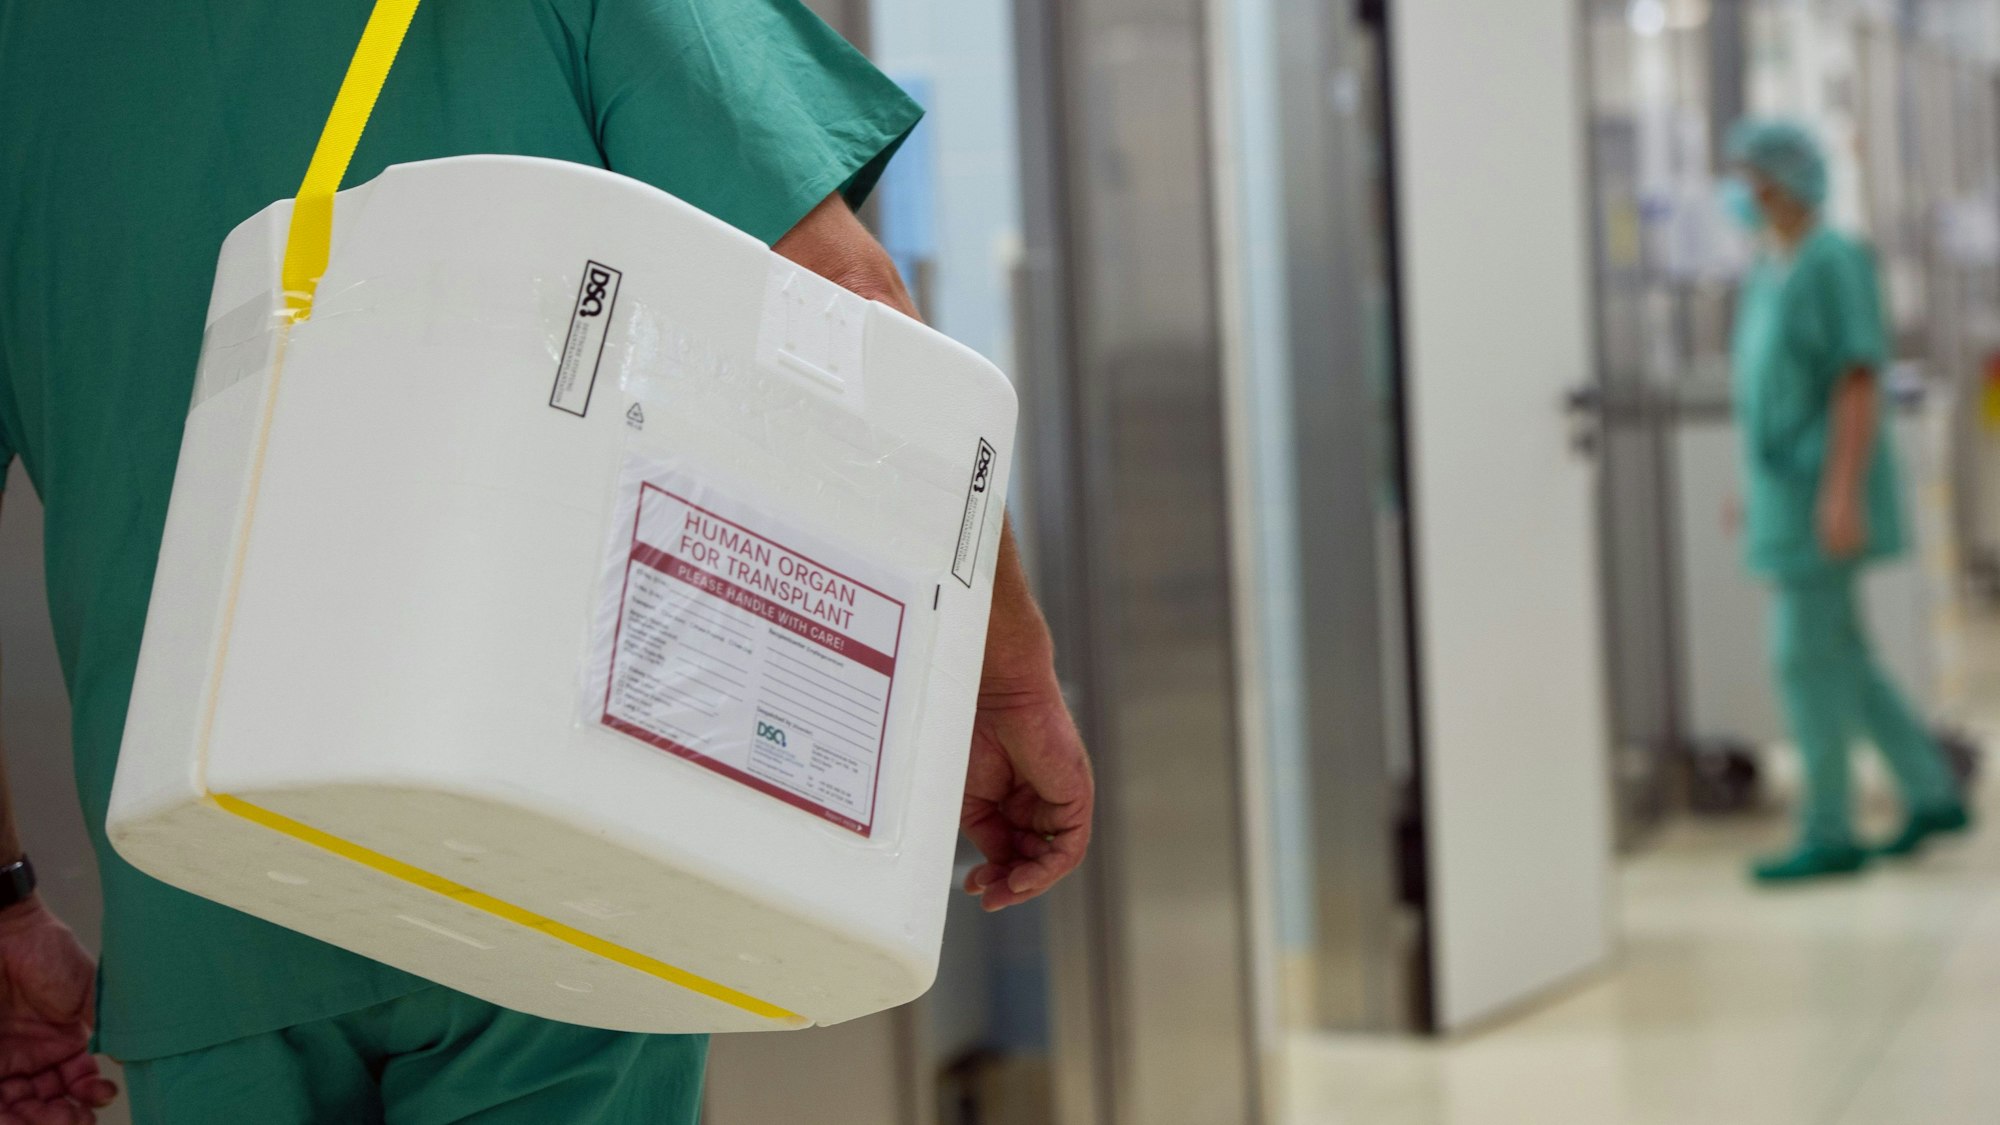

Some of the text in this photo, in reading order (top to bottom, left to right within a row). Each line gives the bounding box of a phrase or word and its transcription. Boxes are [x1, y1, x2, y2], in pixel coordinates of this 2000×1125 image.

[680, 535, 720, 570] FOR
[727, 555, 855, 630] TRANSPLANT
[684, 511, 856, 607] HUMAN ORGAN
[678, 565, 724, 595] PLEASE
[726, 587, 775, 618] HANDLE
[777, 609, 808, 635] WITH
[810, 626, 845, 651] CARE!
